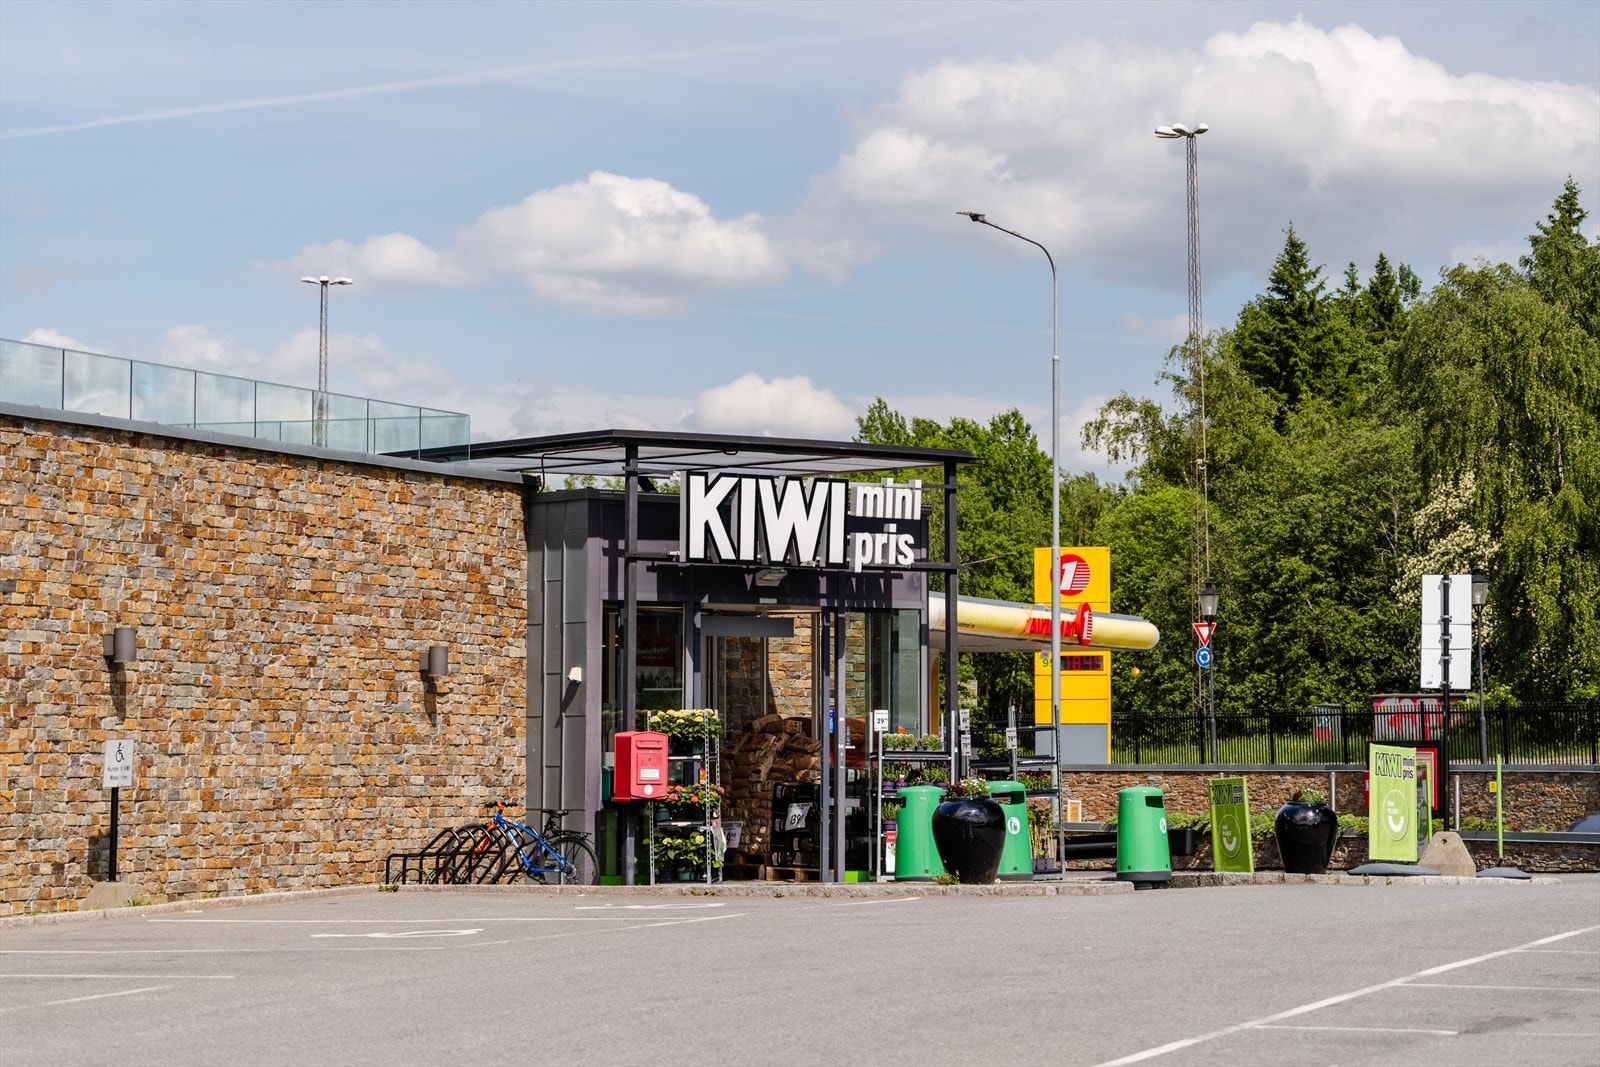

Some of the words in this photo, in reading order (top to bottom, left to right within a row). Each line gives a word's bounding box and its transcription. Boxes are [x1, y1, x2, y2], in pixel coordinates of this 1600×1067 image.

[855, 478, 922, 520] mini
[687, 474, 848, 565] KIWI
[854, 524, 915, 573] pris
[1375, 752, 1402, 778] KIWI
[1403, 767, 1414, 780] pris
[1209, 784, 1233, 806] KIWI
